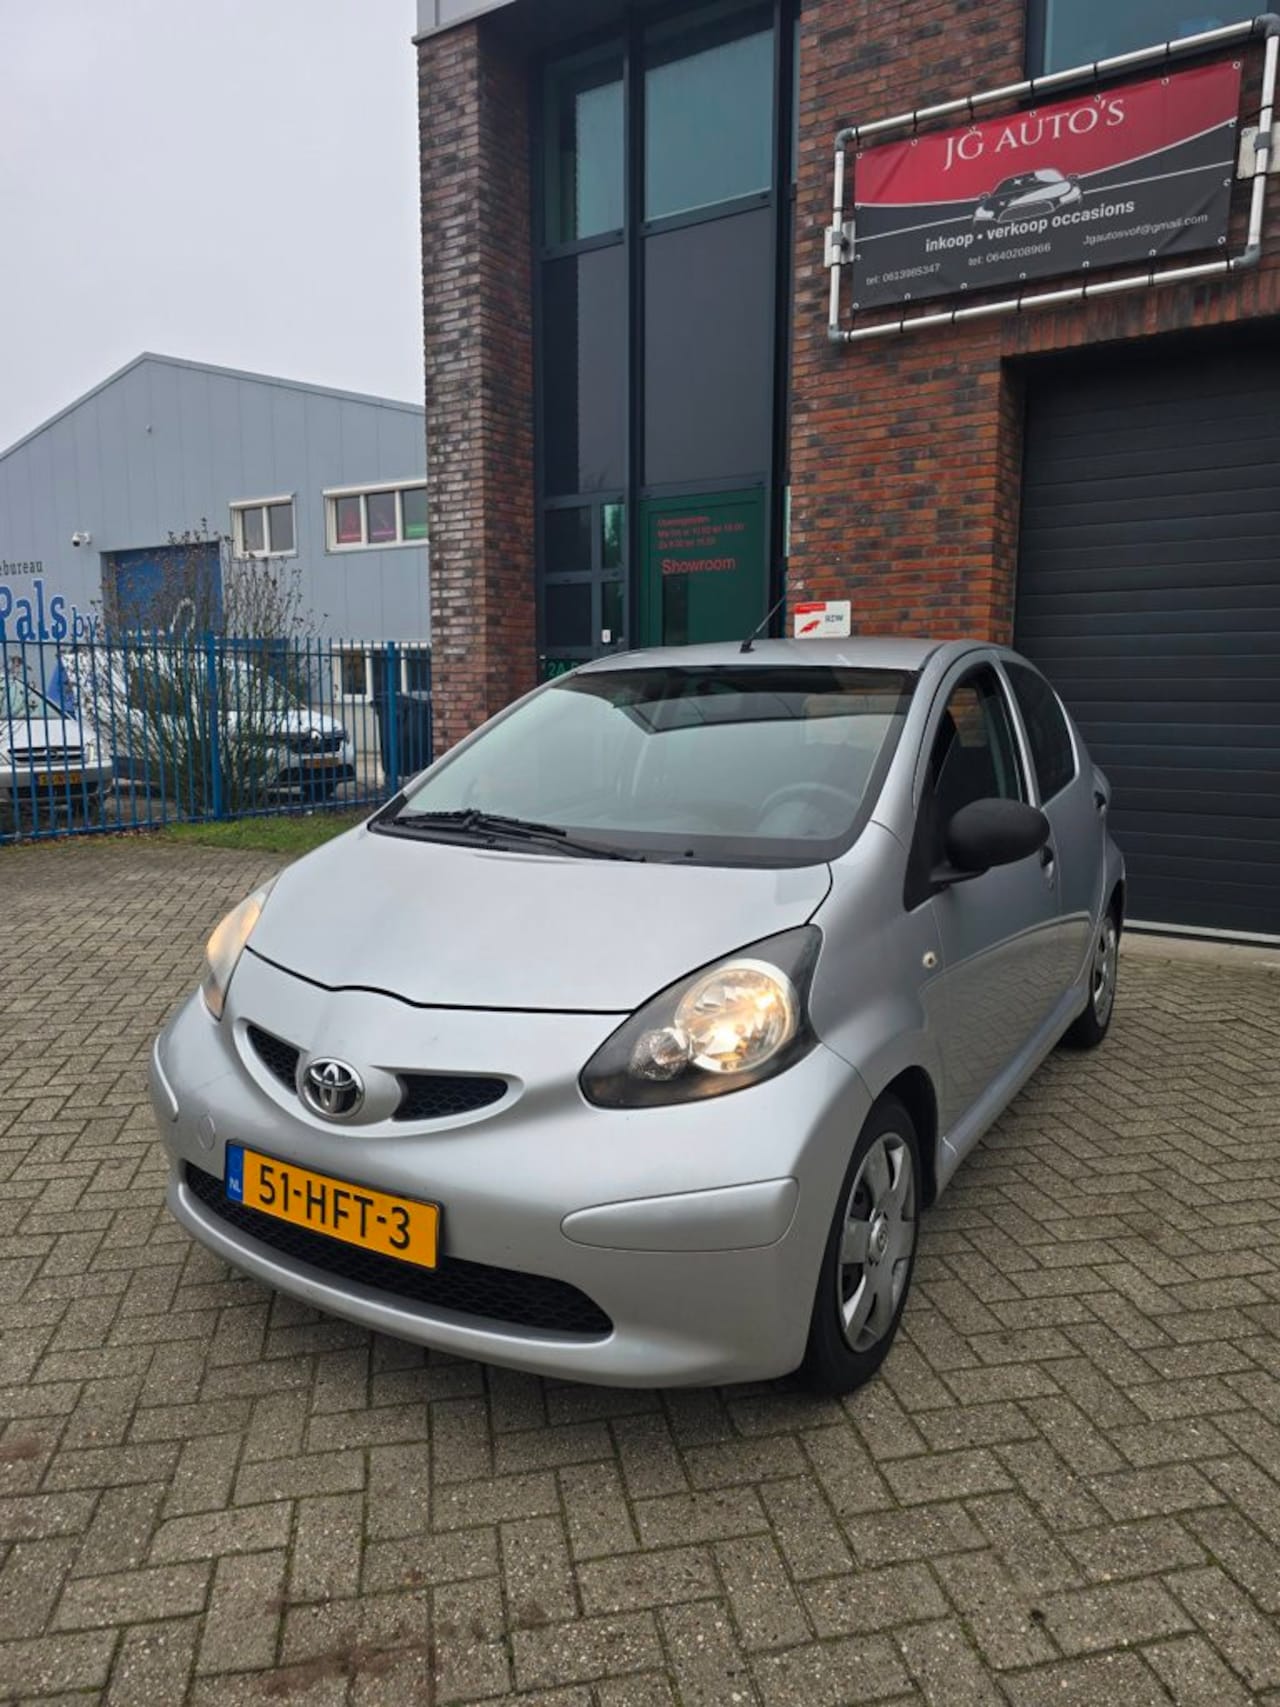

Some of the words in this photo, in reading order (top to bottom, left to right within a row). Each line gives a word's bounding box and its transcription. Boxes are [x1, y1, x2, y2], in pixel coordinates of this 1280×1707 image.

[944, 130, 985, 171] JG
[994, 99, 1125, 152] AUTO'S
[925, 233, 974, 252] inkoop
[987, 219, 1048, 240] verkoop
[1051, 201, 1135, 228] occasions
[662, 558, 736, 575] Showroom
[229, 1176, 241, 1193] NL
[259, 1164, 411, 1250] 51-HFT-3
